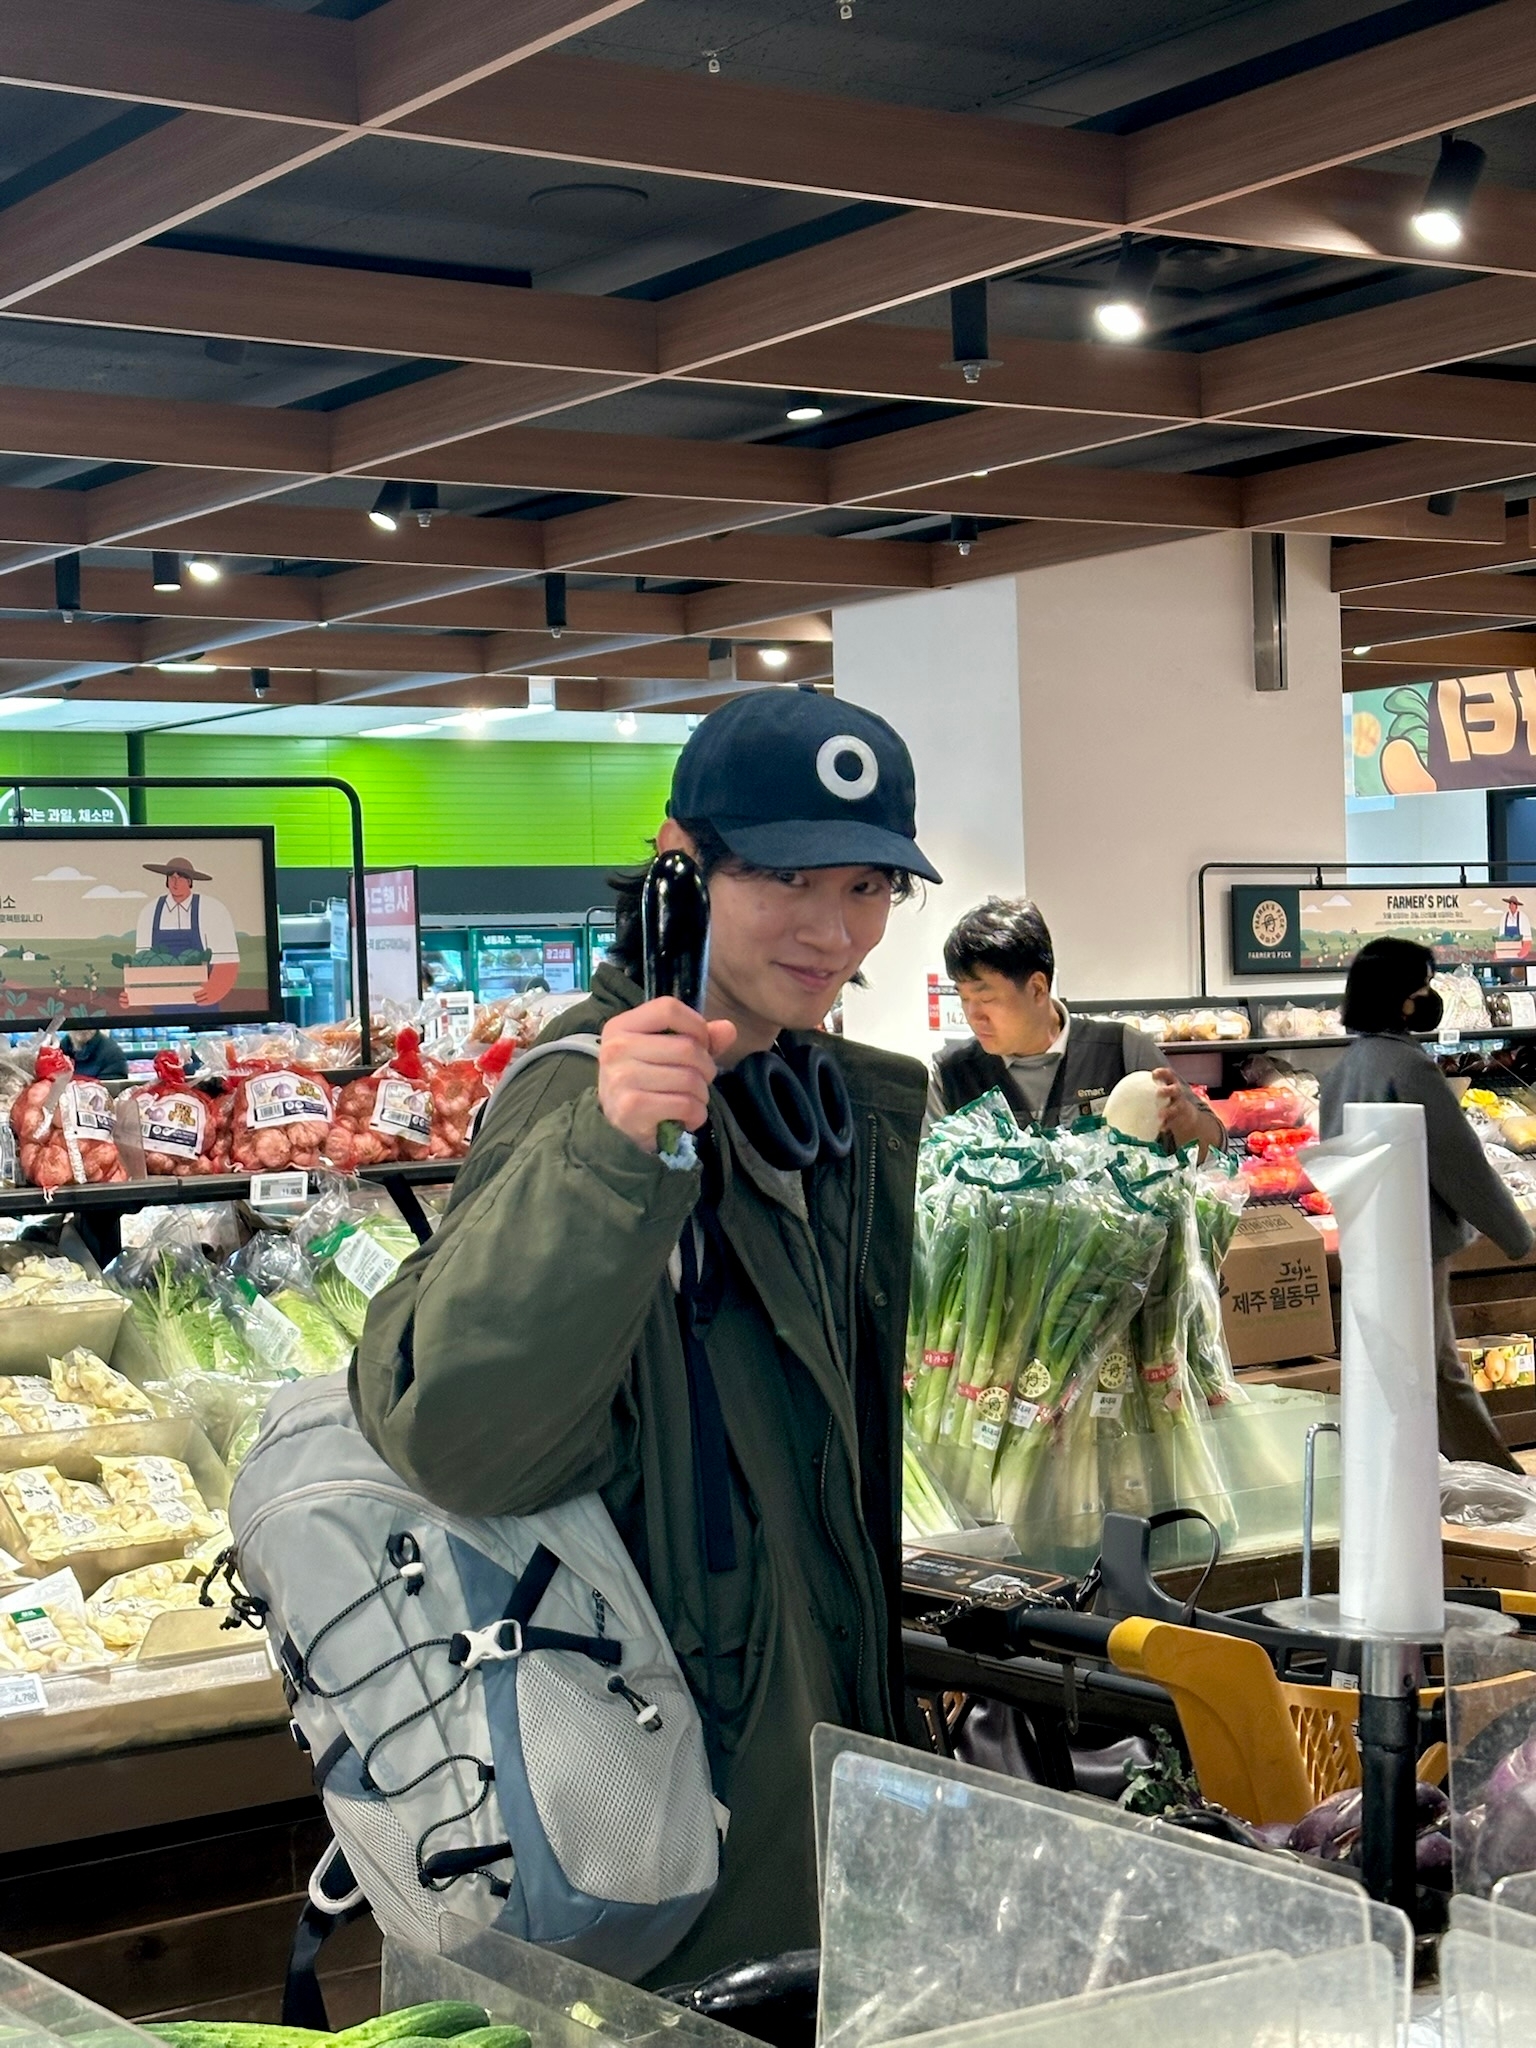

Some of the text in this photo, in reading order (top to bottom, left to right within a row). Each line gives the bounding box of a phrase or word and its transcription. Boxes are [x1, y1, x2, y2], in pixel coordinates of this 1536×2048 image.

[48, 808, 76, 823] 과일,
[79, 809, 114, 823] 채소만
[0, 895, 16, 909] 소
[365, 885, 410, 914] 드행사
[1387, 894, 1459, 910] FARMER'S PICK
[1277, 951, 1292, 959] PICK
[1077, 1087, 1106, 1098] emart
[1279, 1258, 1312, 1281] Jeju
[1232, 1283, 1320, 1315] 제주 월동무
